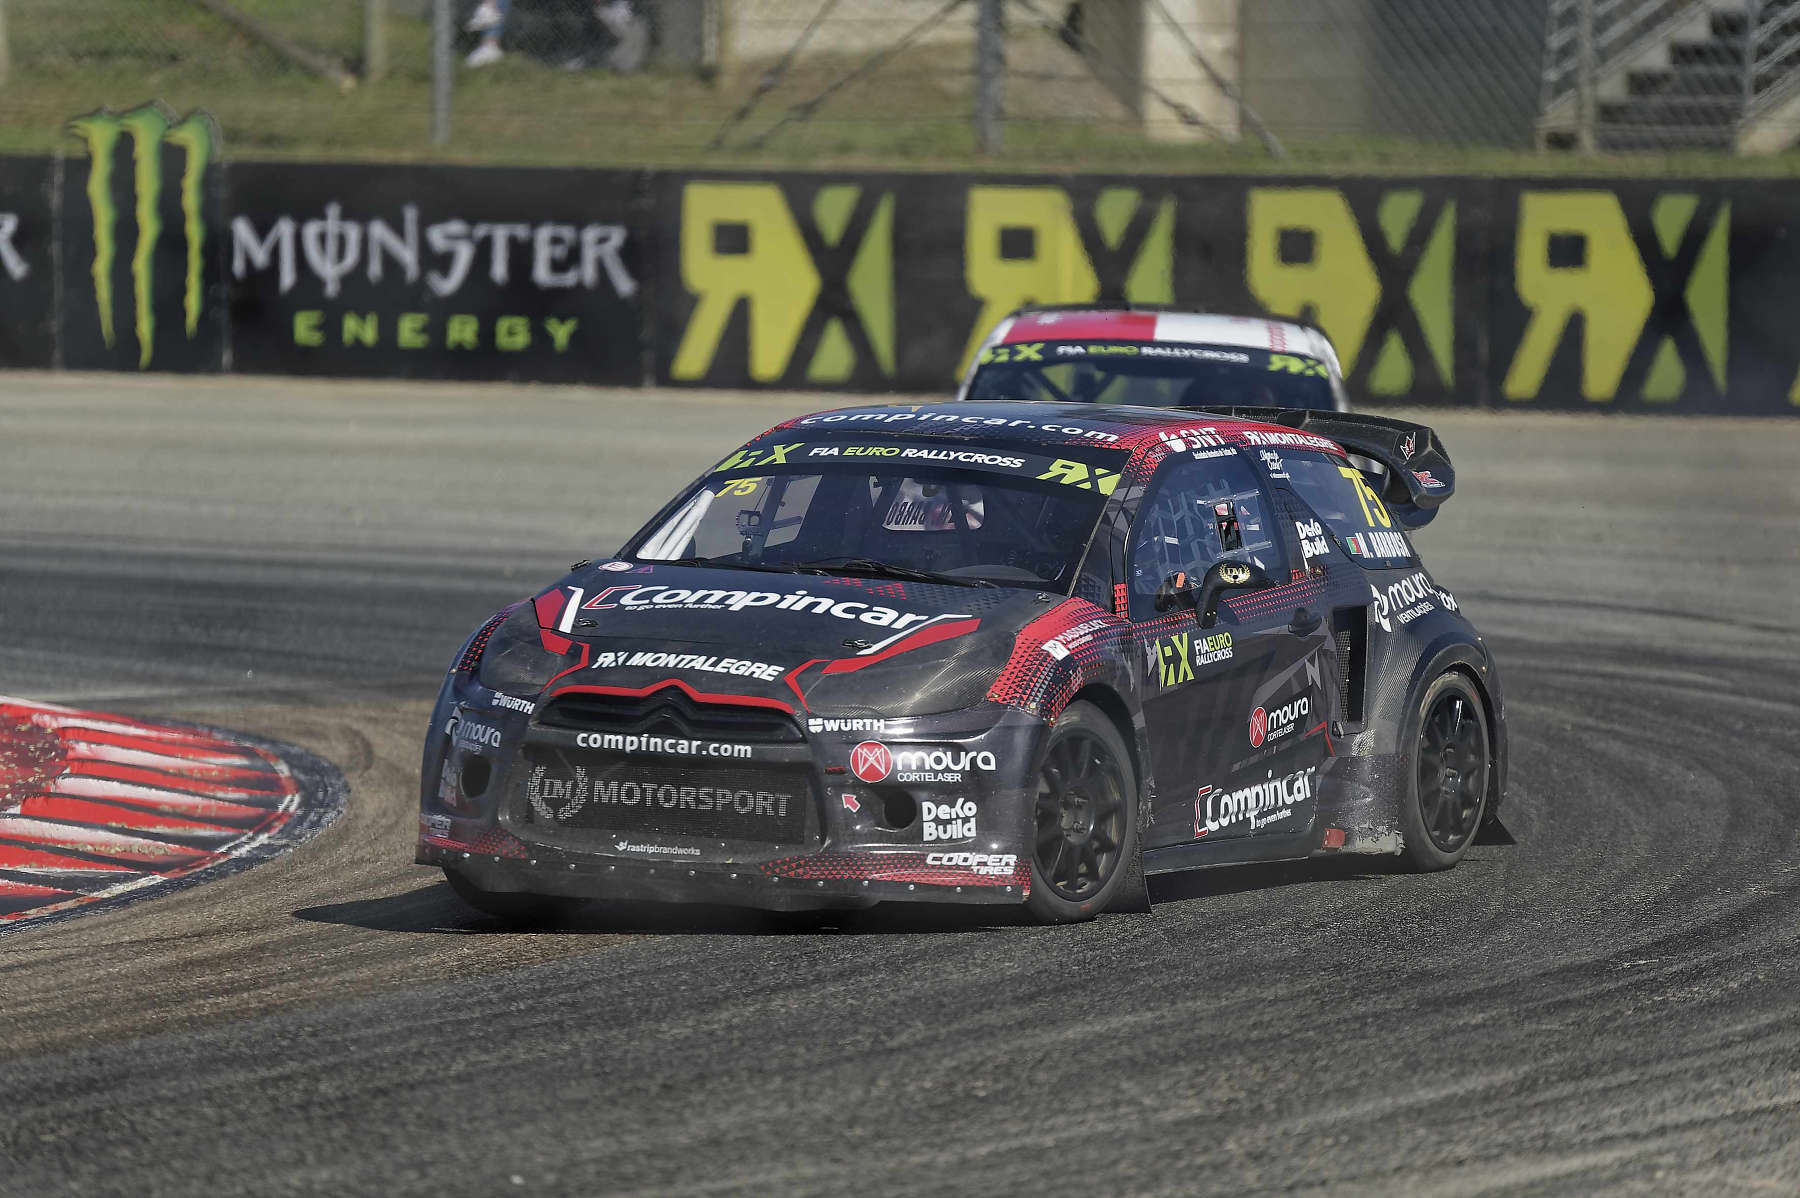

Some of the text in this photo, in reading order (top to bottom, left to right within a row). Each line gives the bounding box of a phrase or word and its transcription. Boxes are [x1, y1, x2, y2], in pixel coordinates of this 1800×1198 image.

[231, 202, 638, 298] MONSTER
[293, 311, 578, 352] ENERGY
[1057, 345, 1086, 356] FIA
[1088, 345, 1139, 357] EURO
[1140, 346, 1249, 364] RALLYCROSS
[800, 411, 1119, 443] compincar.com
[1266, 431, 1339, 451] MONTALEGRE
[808, 447, 840, 457] FIA
[842, 446, 900, 458] EURO
[900, 447, 1026, 469] RALLYCROSS
[714, 477, 763, 498] 75
[1300, 536, 1330, 559] Build
[620, 585, 929, 630] Compincar
[625, 651, 785, 682] MONTALEGRE
[1196, 647, 1233, 666] RALLYCROSS
[823, 718, 885, 732] WÜRTH
[1267, 696, 1309, 732] moura
[464, 720, 501, 748] moura
[576, 733, 752, 758] compincar.com
[896, 750, 997, 772] moura
[897, 772, 962, 783] CORTELASER
[593, 780, 793, 817] MOTORSPORT
[1205, 766, 1316, 831] Compincar
[923, 818, 977, 841] Build
[926, 852, 1018, 866] COOPER
[970, 865, 1015, 876] TIRES
